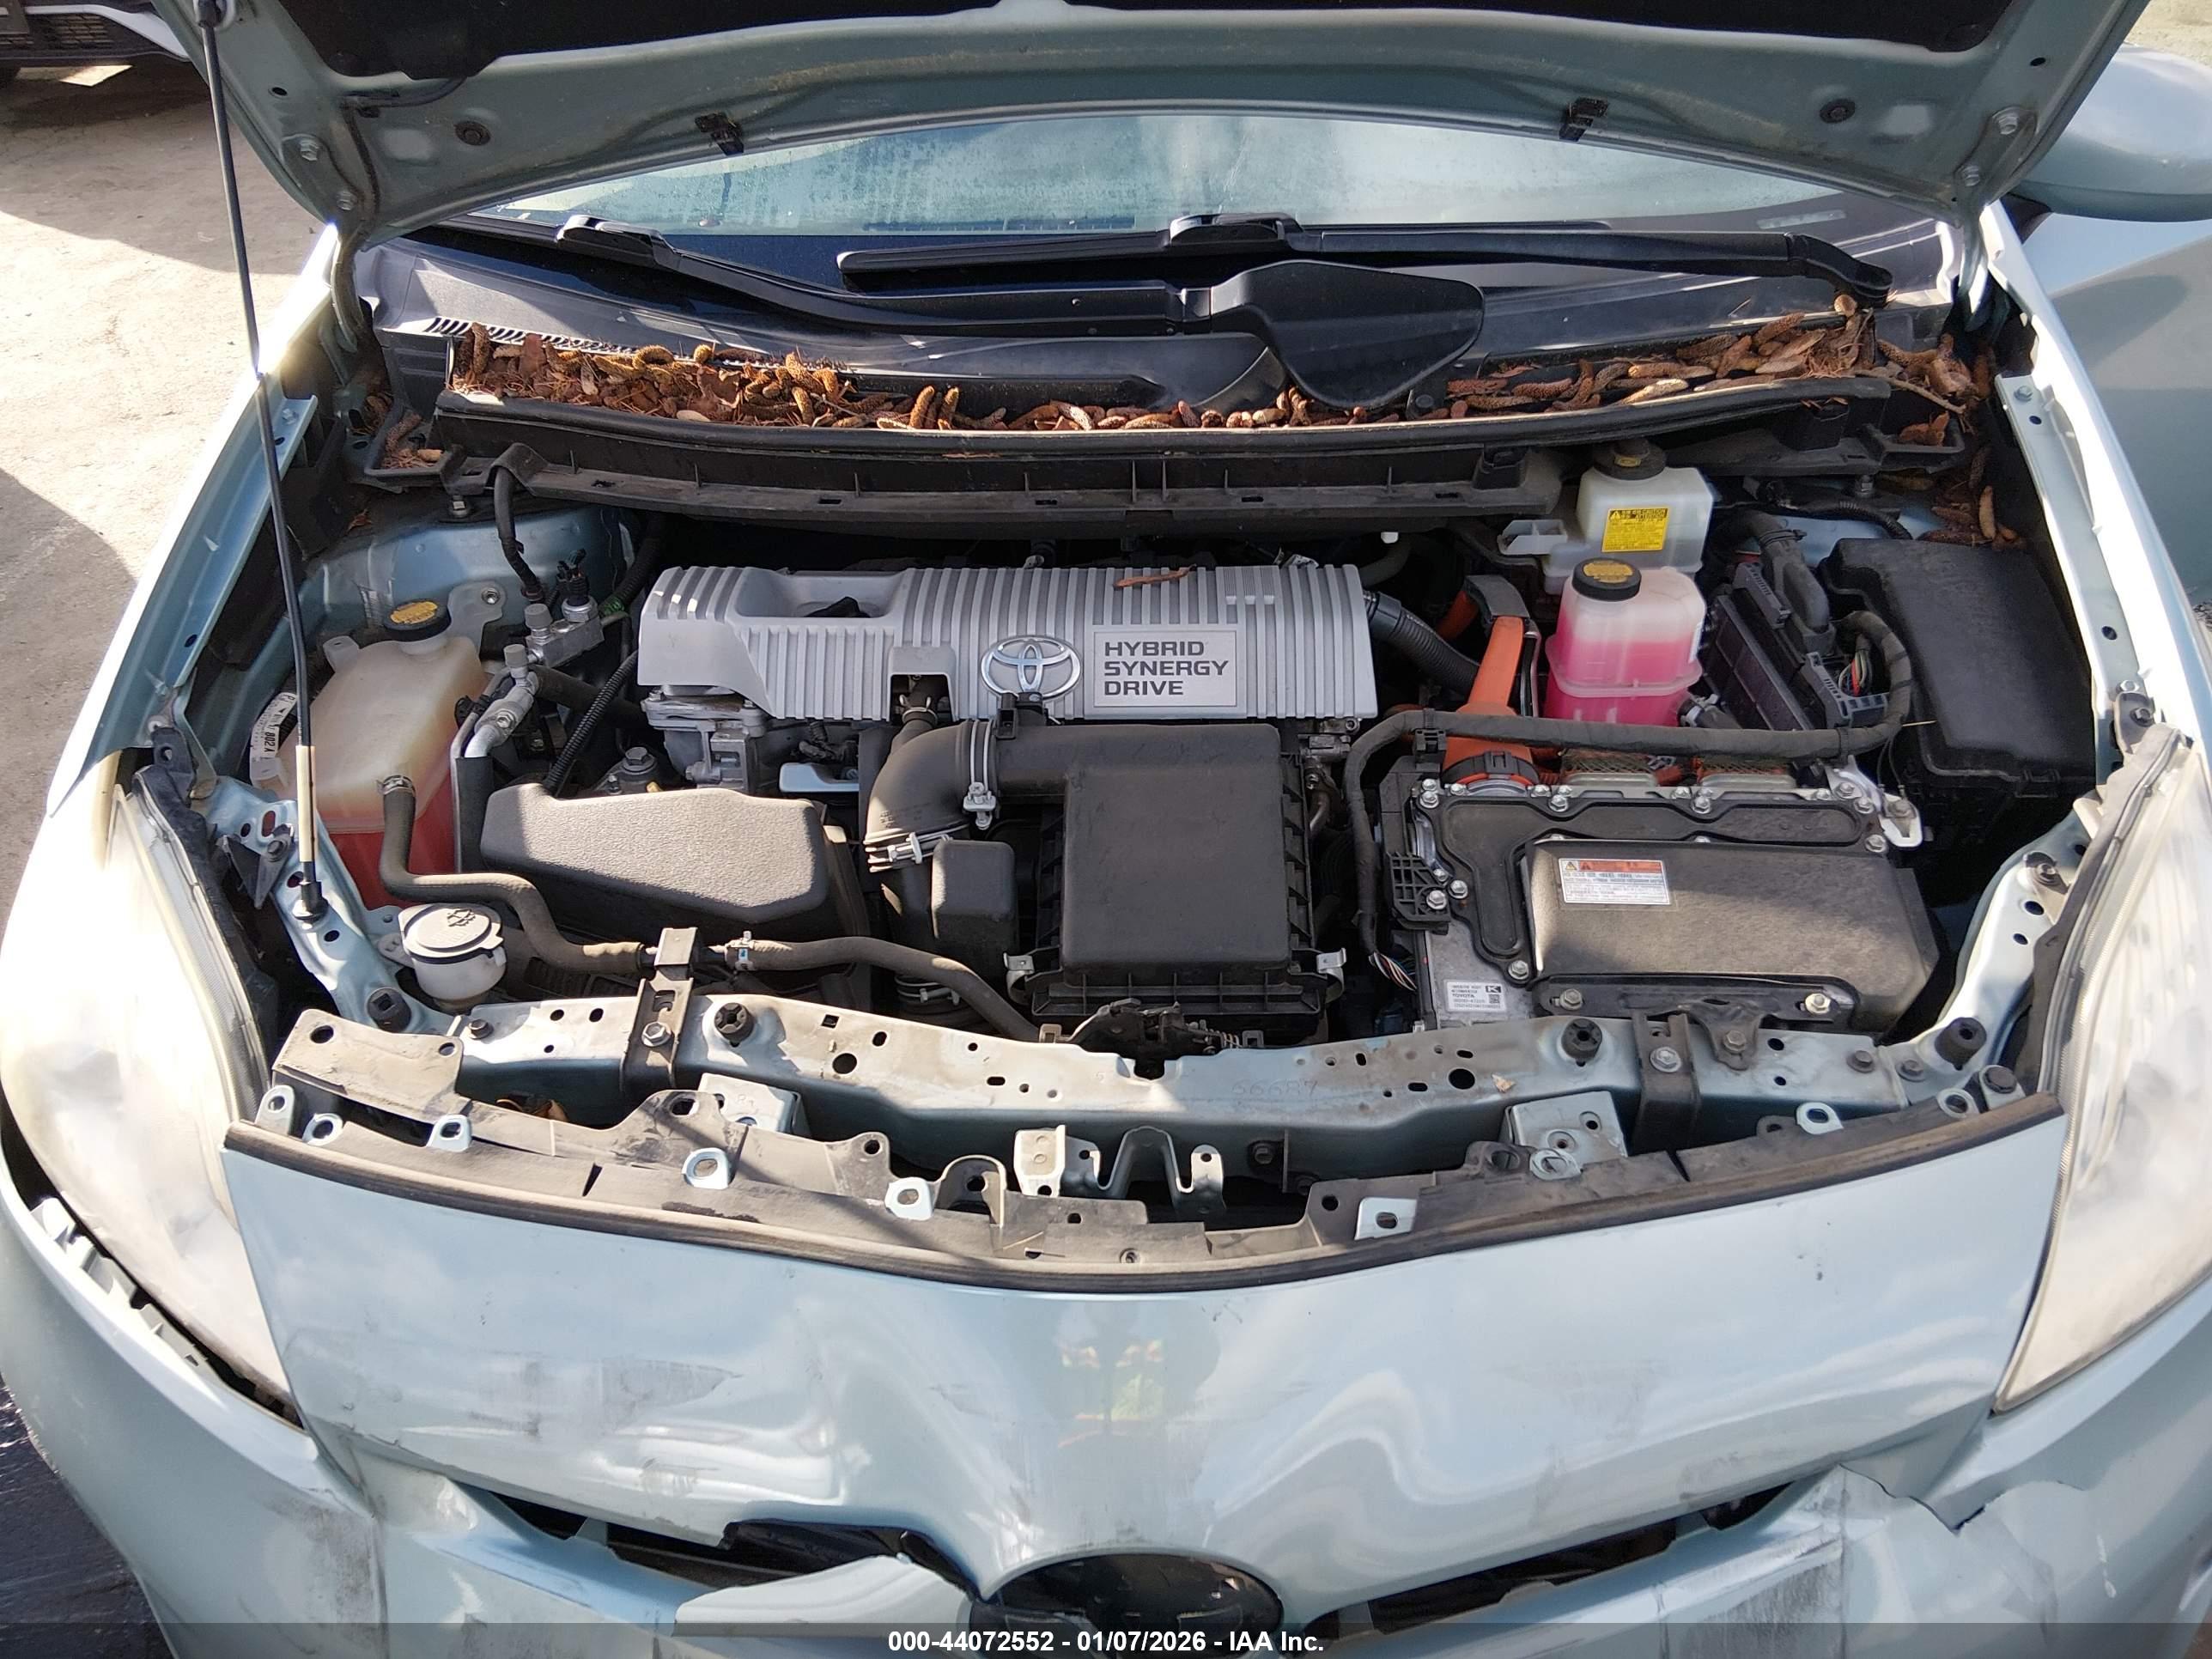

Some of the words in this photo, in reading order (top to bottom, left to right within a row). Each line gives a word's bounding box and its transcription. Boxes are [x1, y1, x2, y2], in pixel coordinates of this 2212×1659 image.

[1105, 641, 1204, 656] HYBRID
[1105, 660, 1229, 676] SYNERGY
[1104, 680, 1183, 696] DRIVE
